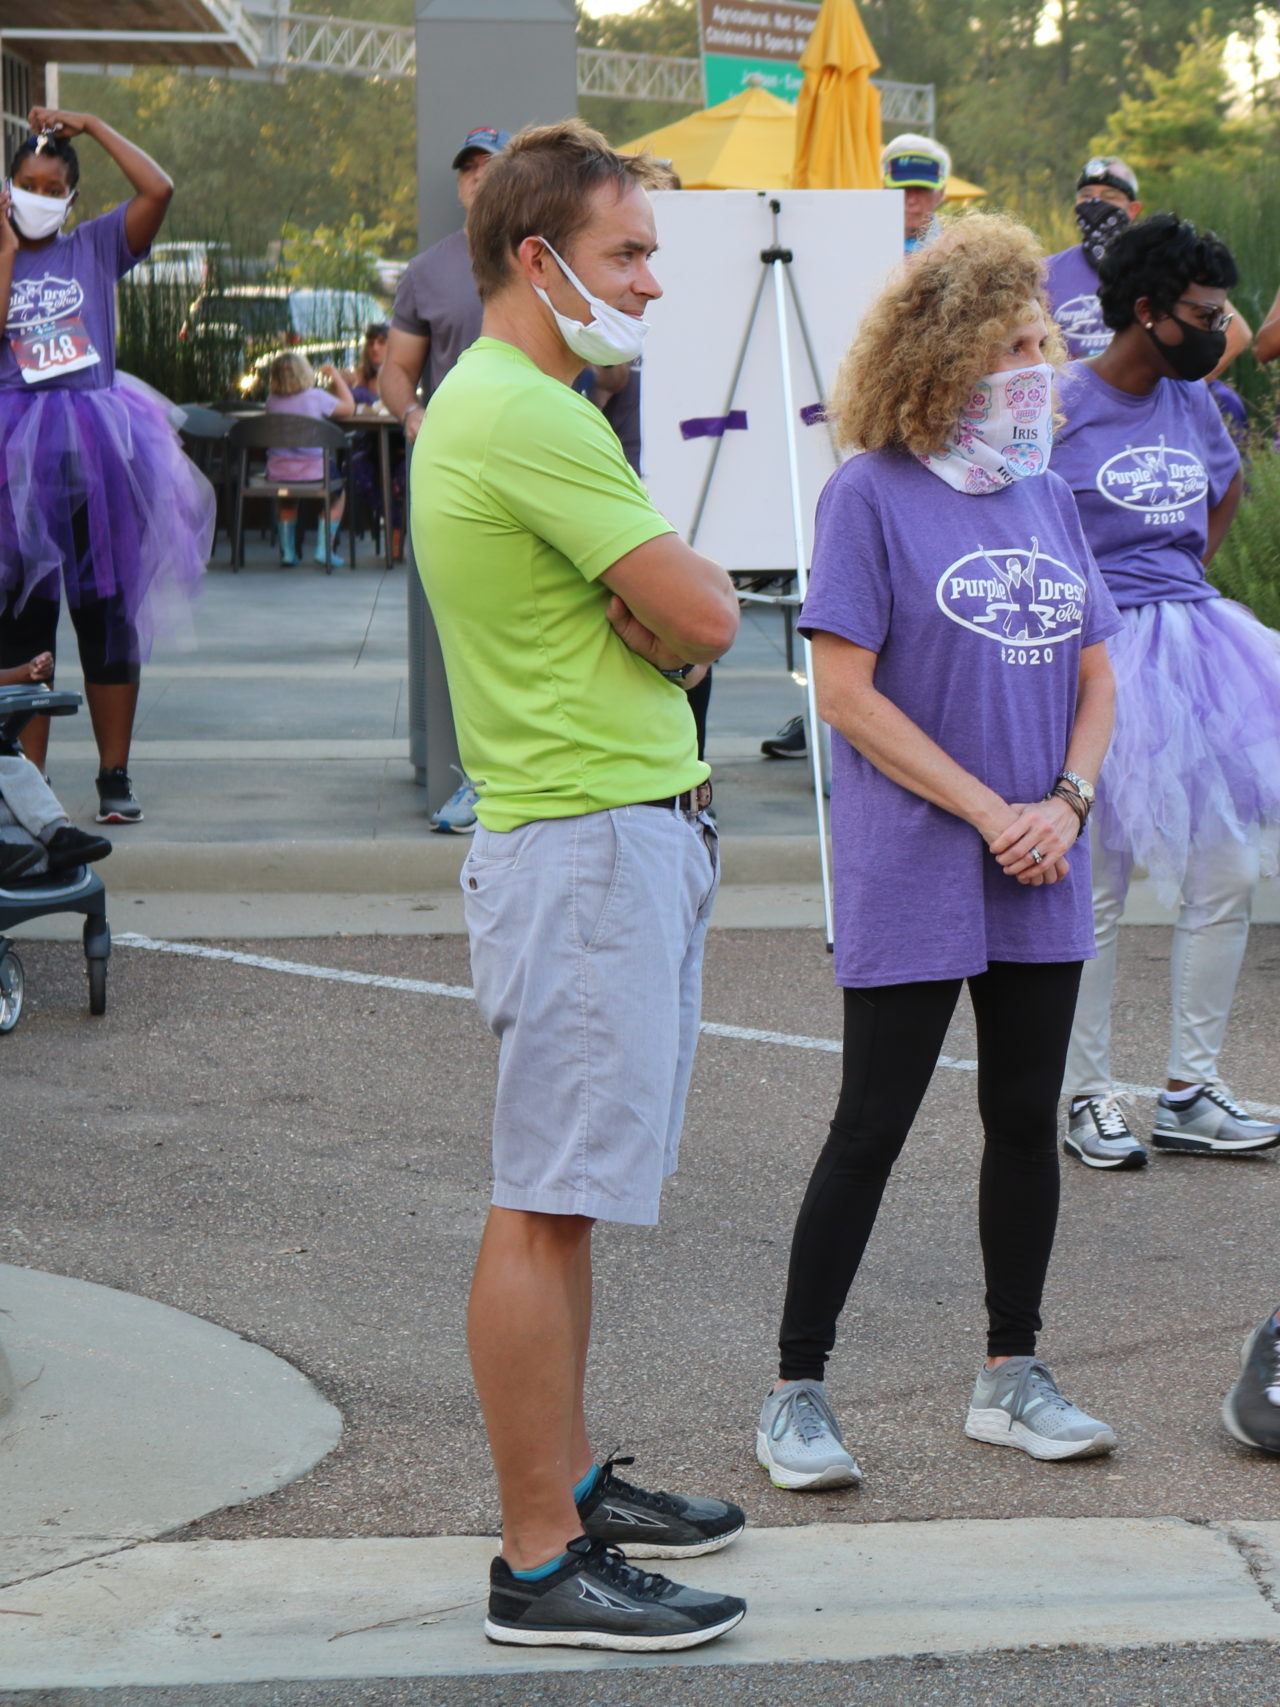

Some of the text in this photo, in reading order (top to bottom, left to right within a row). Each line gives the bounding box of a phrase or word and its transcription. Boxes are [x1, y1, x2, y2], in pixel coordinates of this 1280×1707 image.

[32, 334, 77, 369] 248
[1105, 463, 1206, 486] Purple Dress
[1144, 510, 1186, 525] #2020
[950, 577, 1007, 603] Purple
[1001, 647, 1054, 666] #2020
